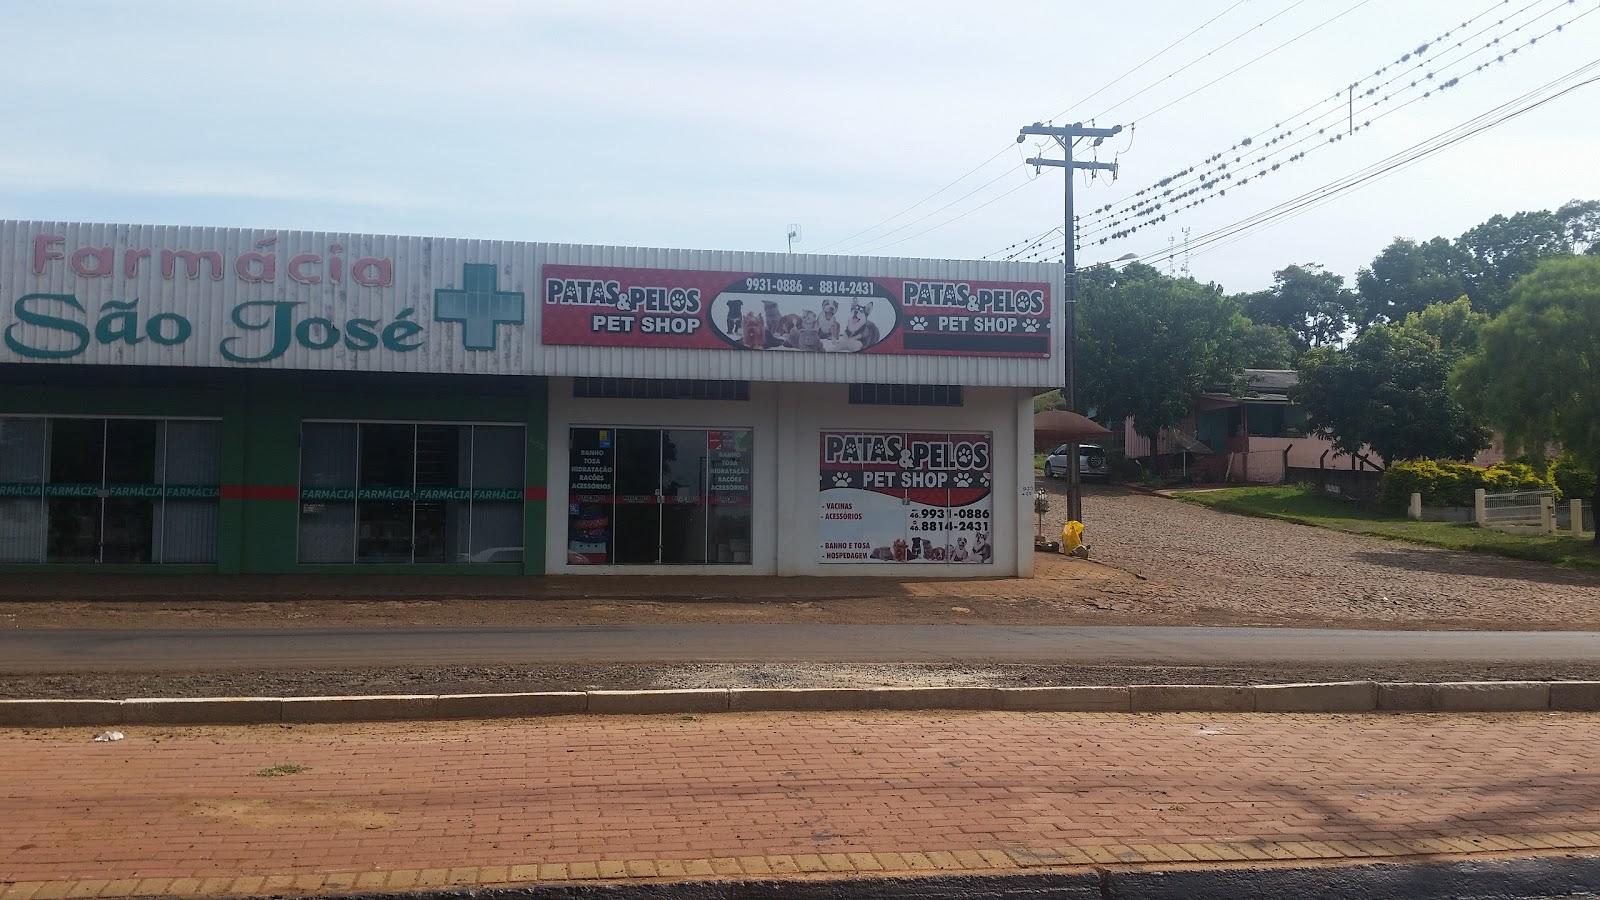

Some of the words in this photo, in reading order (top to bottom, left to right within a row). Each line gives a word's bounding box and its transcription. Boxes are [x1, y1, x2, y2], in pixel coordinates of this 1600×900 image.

[32, 234, 395, 288] Farmácia
[746, 278, 803, 293] 9931-0886
[819, 280, 875, 295] 8814-2431
[4, 293, 192, 359] São
[219, 301, 425, 363] José
[592, 315, 635, 332] PET
[641, 316, 701, 334] SHOP
[938, 316, 969, 332] PET
[974, 317, 1018, 333] SHOP
[863, 472, 895, 487] PET
[901, 472, 948, 488] SHOP
[44, 485, 98, 497] FARMÁCIA
[109, 485, 163, 498] FARMÁCIA
[166, 486, 220, 498] FARMÁCIA
[301, 487, 354, 500] FARMÁCIA
[357, 487, 411, 500] FARMÁCIA
[418, 488, 471, 500] FARMÁCIA
[472, 488, 523, 500] FARMÁCIA
